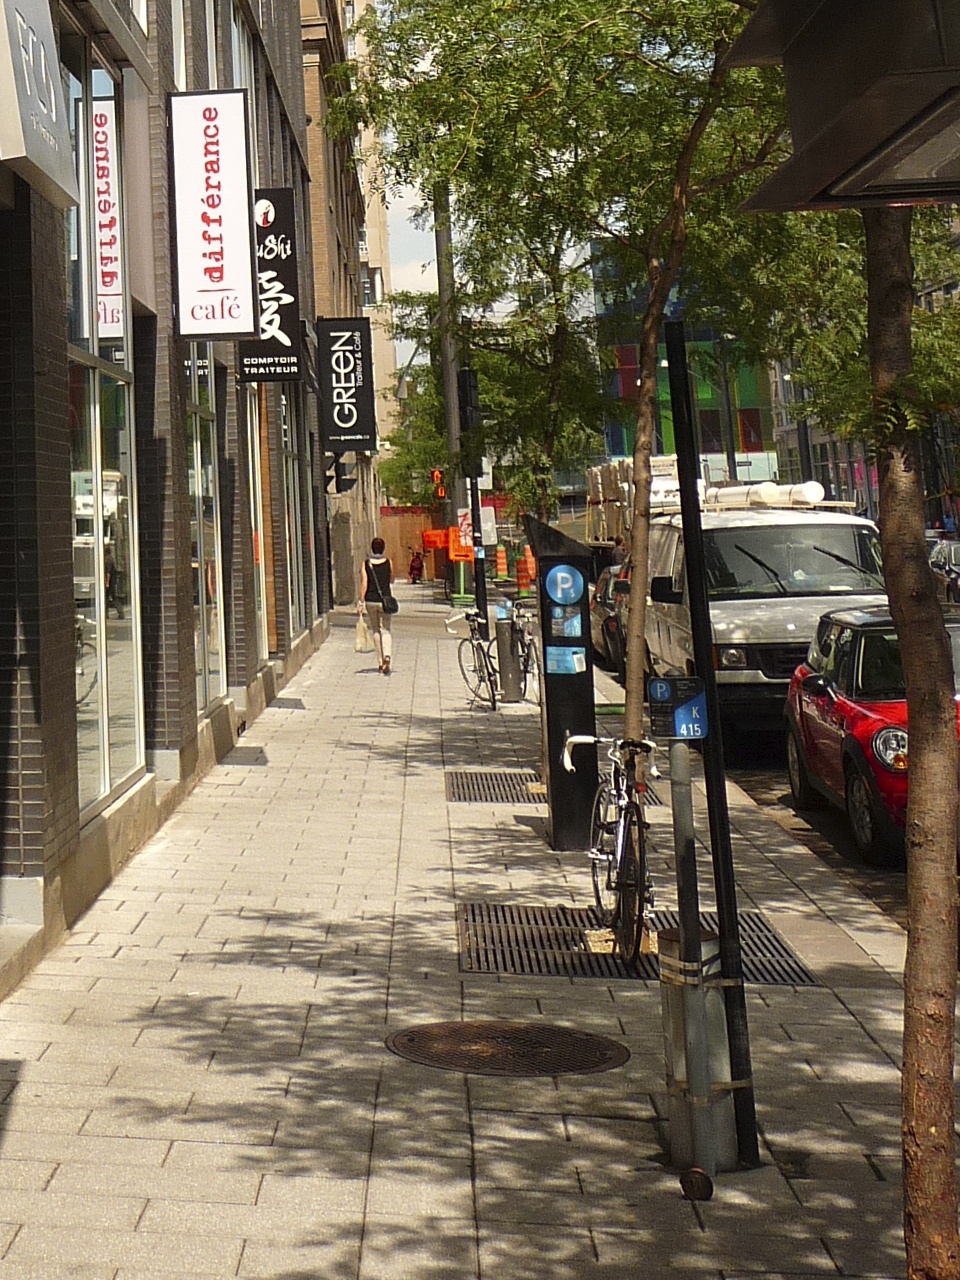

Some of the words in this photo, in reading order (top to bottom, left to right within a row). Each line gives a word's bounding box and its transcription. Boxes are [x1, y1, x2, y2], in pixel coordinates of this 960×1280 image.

[202, 106, 224, 284] différance
[190, 295, 241, 322] café
[243, 356, 298, 365] COMPTOIR
[243, 366, 299, 375] TRAITEUR
[692, 706, 700, 719] K
[680, 723, 701, 737] 415
